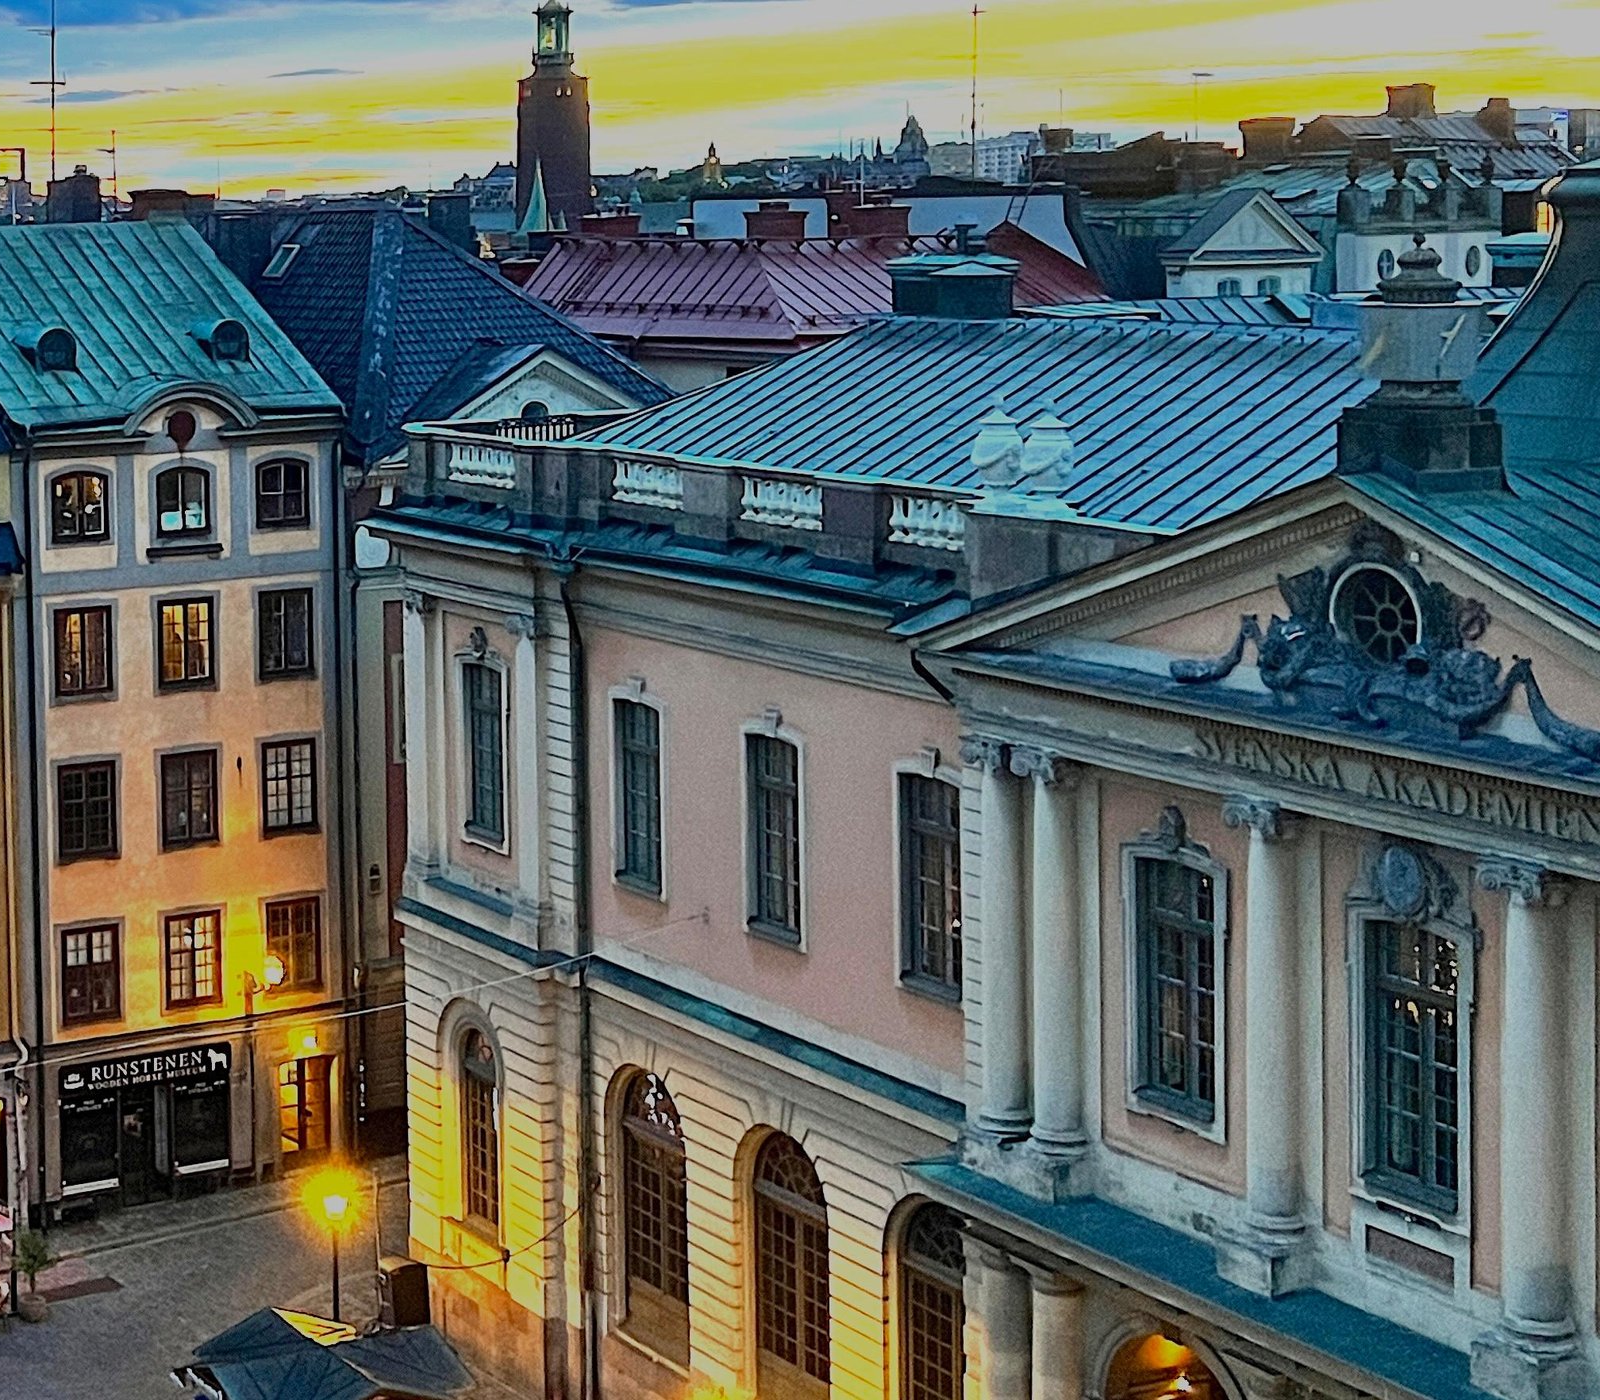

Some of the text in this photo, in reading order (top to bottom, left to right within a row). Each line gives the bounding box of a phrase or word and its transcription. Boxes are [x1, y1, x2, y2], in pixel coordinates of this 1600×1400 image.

[1196, 731, 1600, 843] SVENSKA AKADEMIEN
[87, 1065, 207, 1091] WOODEN HORSE MUSEUM
[91, 1051, 203, 1081] RUNSTENEN
